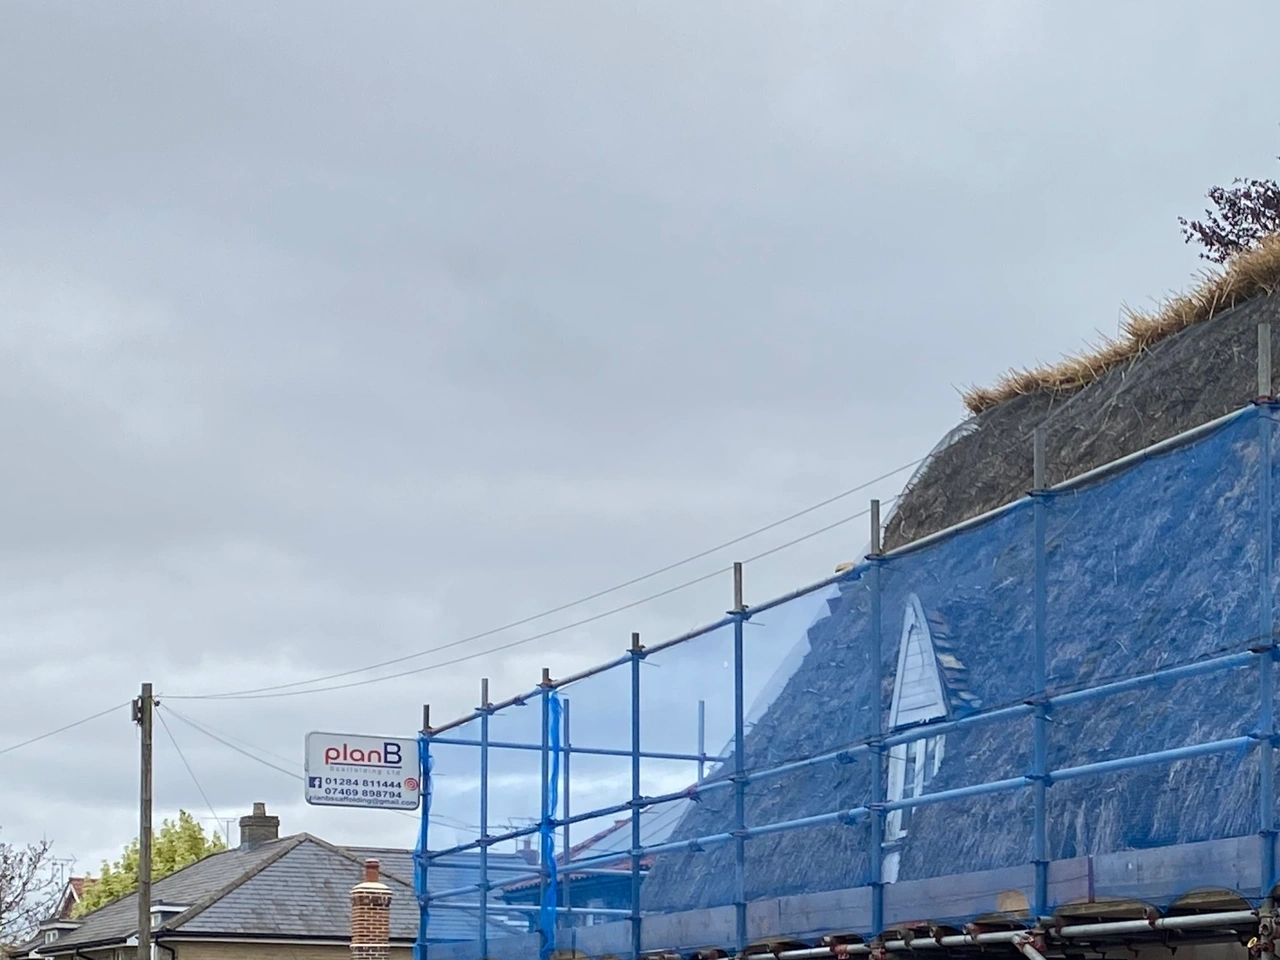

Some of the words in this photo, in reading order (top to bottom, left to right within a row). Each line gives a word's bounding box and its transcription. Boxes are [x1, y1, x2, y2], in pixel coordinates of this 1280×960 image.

[324, 742, 402, 765] planB
[325, 777, 359, 787] 01284
[362, 780, 402, 789] 811444
[325, 787, 358, 796] 07469
[362, 789, 402, 799] 898794
